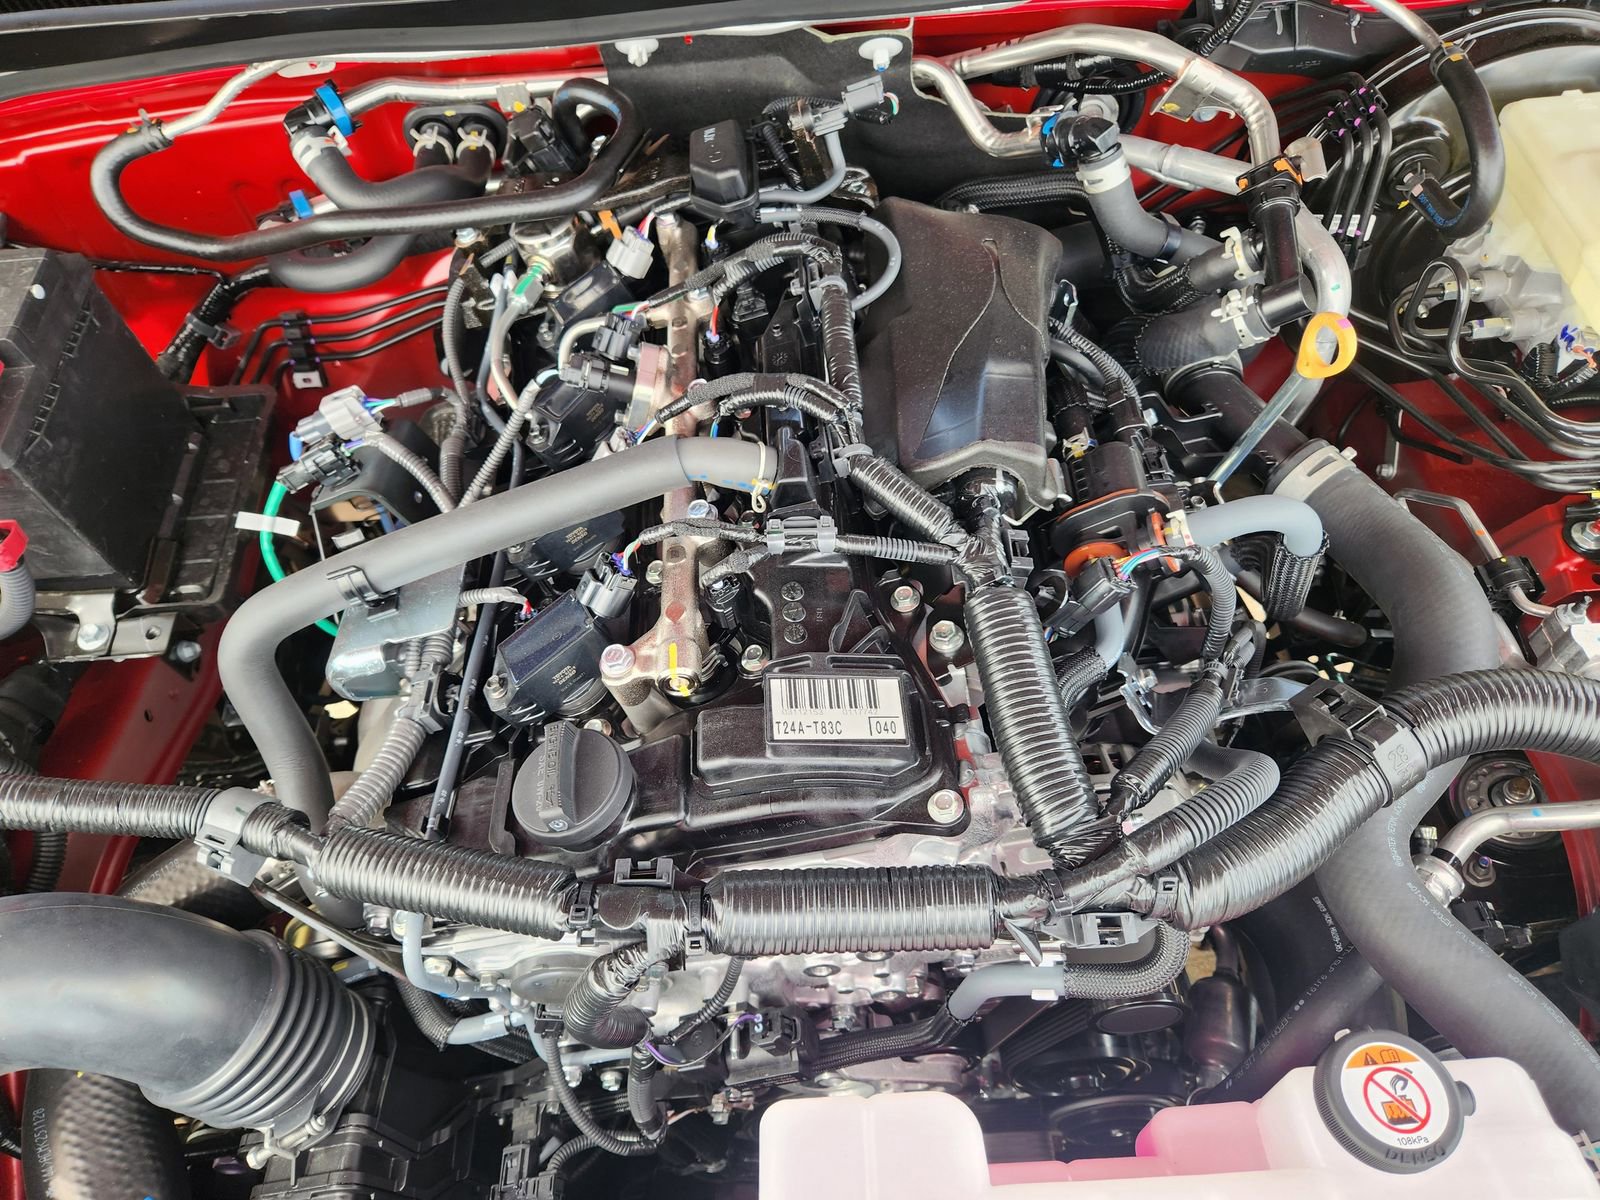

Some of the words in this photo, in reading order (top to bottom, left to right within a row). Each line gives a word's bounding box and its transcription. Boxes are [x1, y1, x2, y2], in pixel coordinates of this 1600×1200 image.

[552, 665, 572, 680] TOYOTA
[558, 669, 577, 685] DENSO
[776, 720, 843, 735] T24A-T83C
[875, 720, 897, 735] 040
[547, 724, 559, 758] ENGINE
[535, 754, 546, 778] SAE
[547, 761, 556, 777] OIL
[1396, 1135, 1430, 1146] 108kPa
[1385, 1142, 1446, 1165] DENSO
